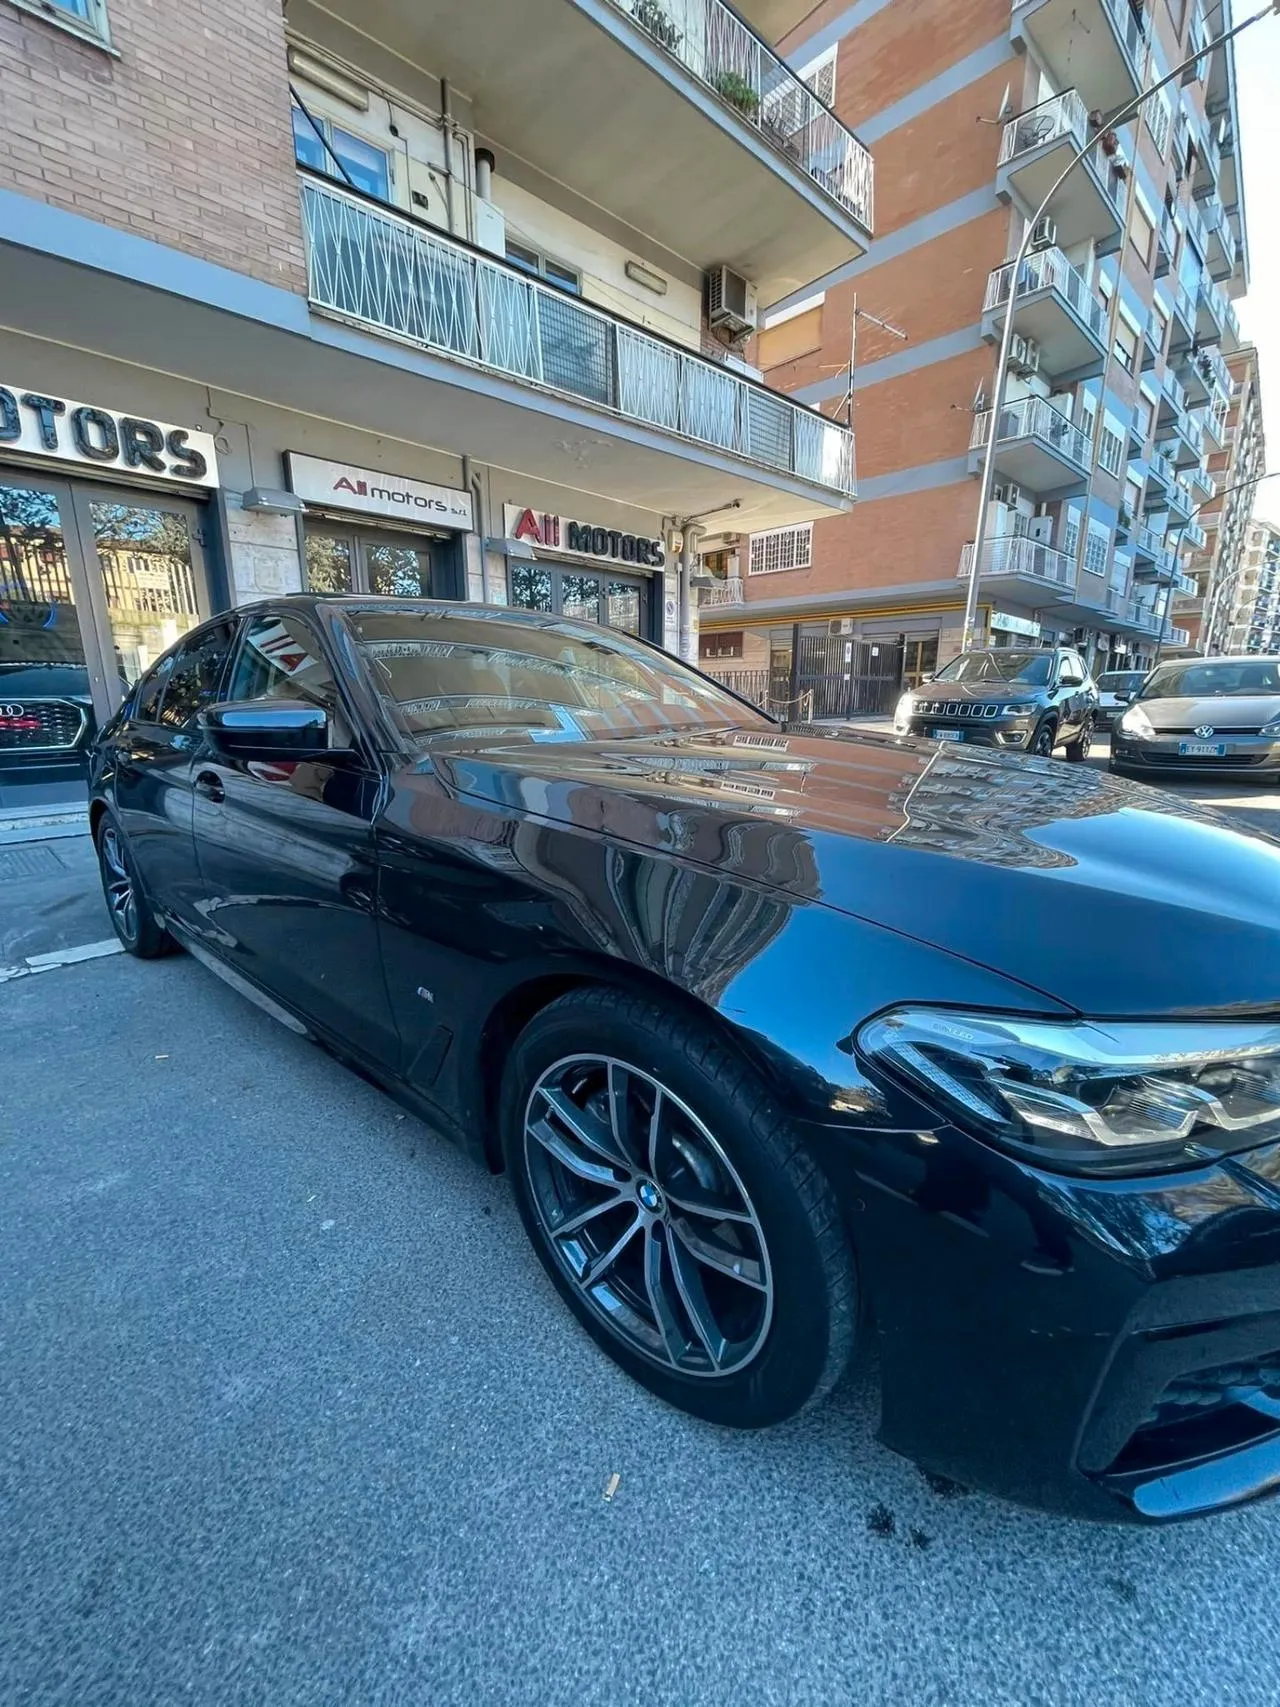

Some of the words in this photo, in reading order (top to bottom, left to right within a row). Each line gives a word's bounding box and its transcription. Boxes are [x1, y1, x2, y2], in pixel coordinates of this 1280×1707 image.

[333, 477, 367, 497] All
[371, 487, 447, 512] motors
[515, 508, 560, 547] All
[568, 521, 665, 567] MOTORS
